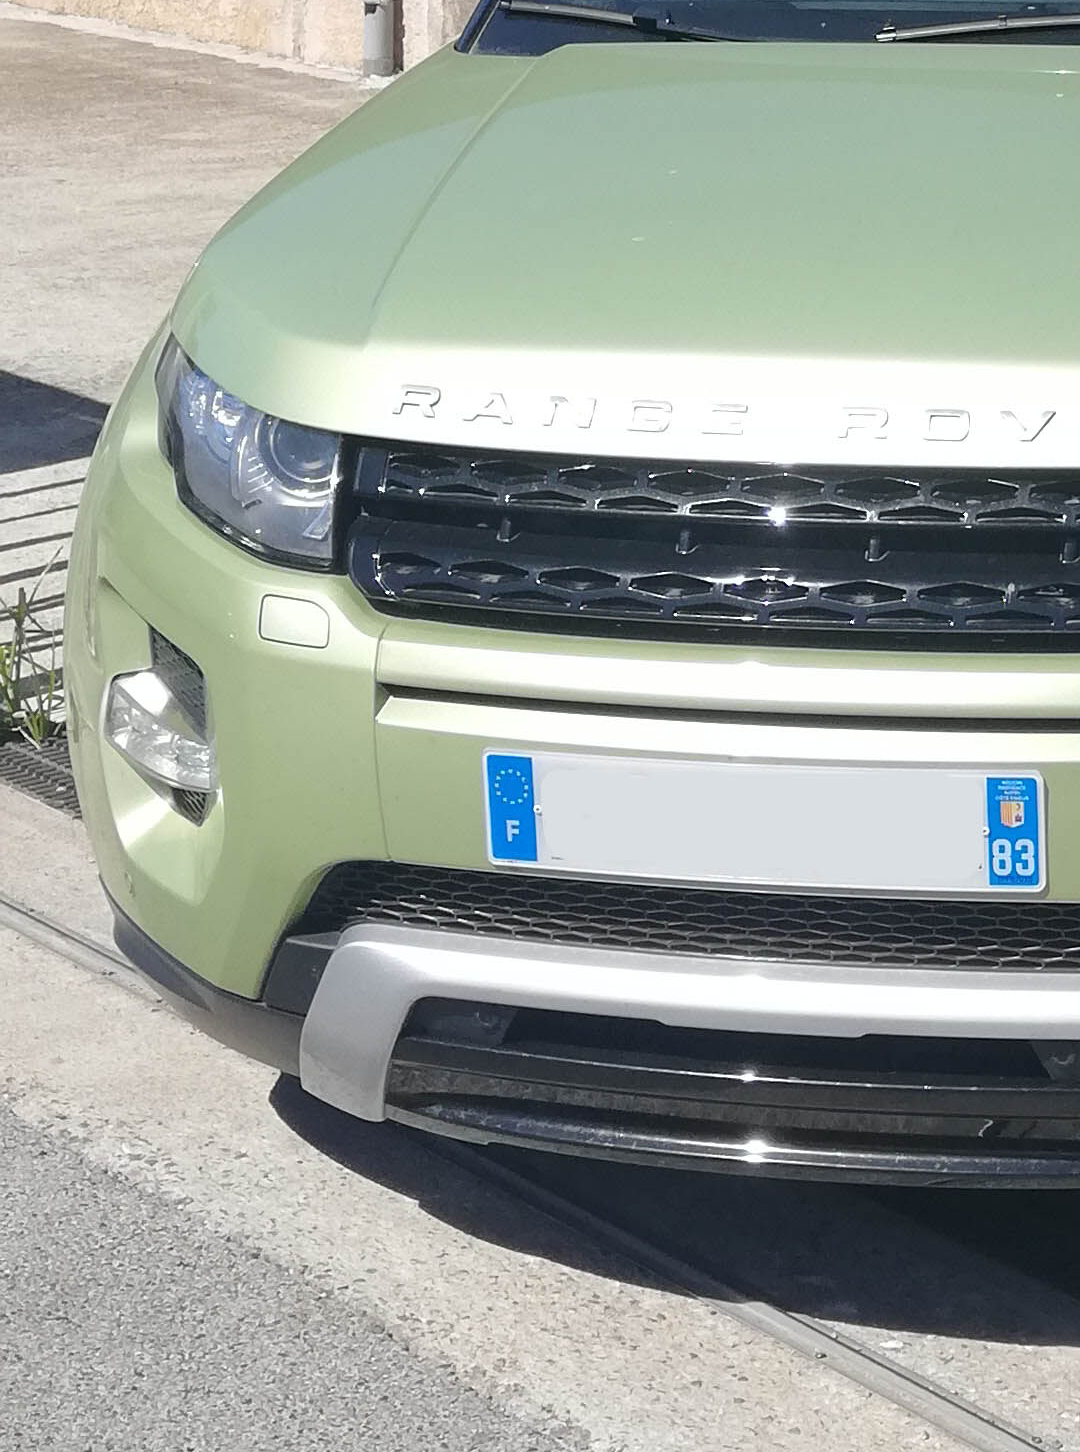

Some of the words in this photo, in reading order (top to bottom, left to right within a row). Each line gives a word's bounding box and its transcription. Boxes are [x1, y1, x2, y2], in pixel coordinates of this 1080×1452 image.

[392, 383, 750, 436] RANGE
[505, 819, 520, 843] F
[991, 838, 1035, 877] 83
